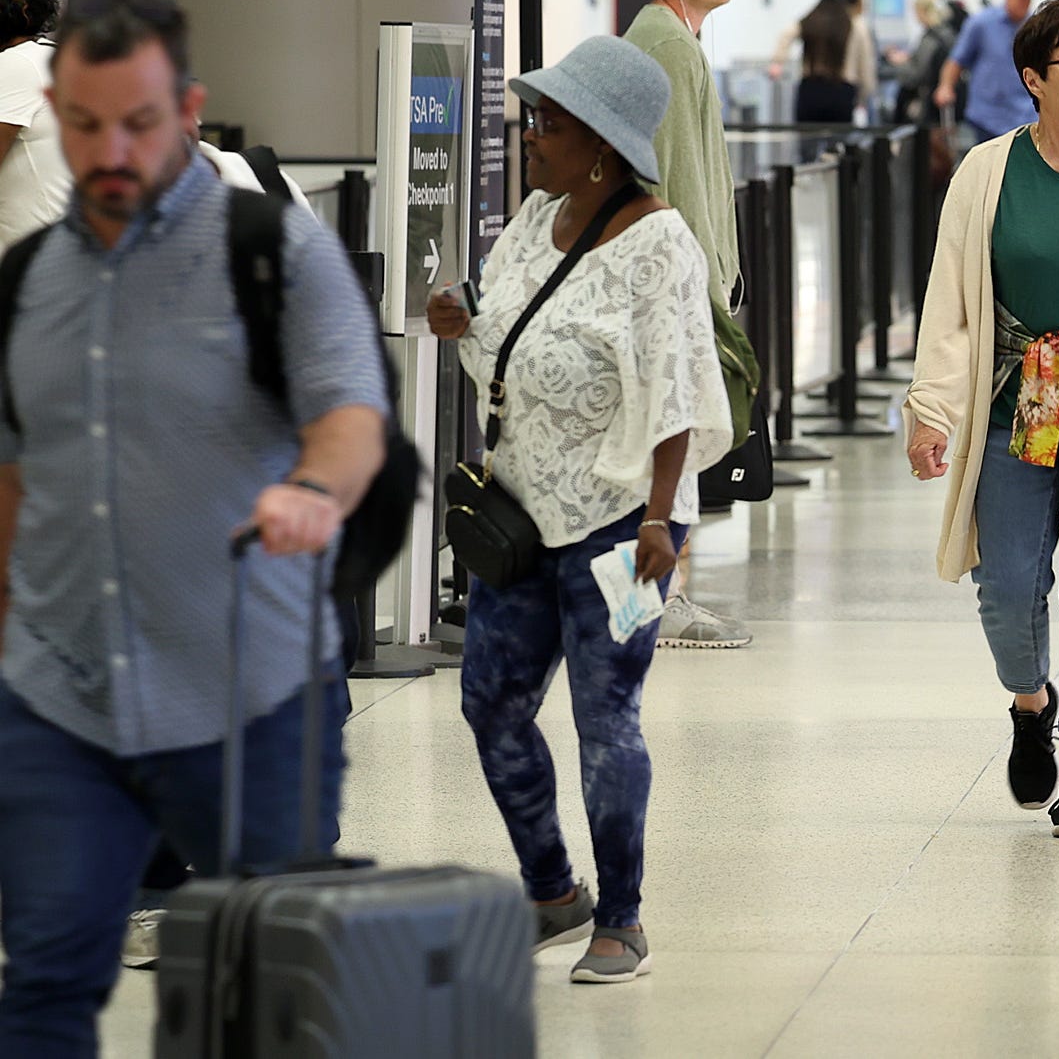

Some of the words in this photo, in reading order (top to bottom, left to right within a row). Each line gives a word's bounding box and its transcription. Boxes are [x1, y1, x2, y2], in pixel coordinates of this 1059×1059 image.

[429, 95, 445, 124] Pre
[413, 146, 439, 171] Moved
[439, 147, 448, 171] to
[449, 182, 455, 205] 1
